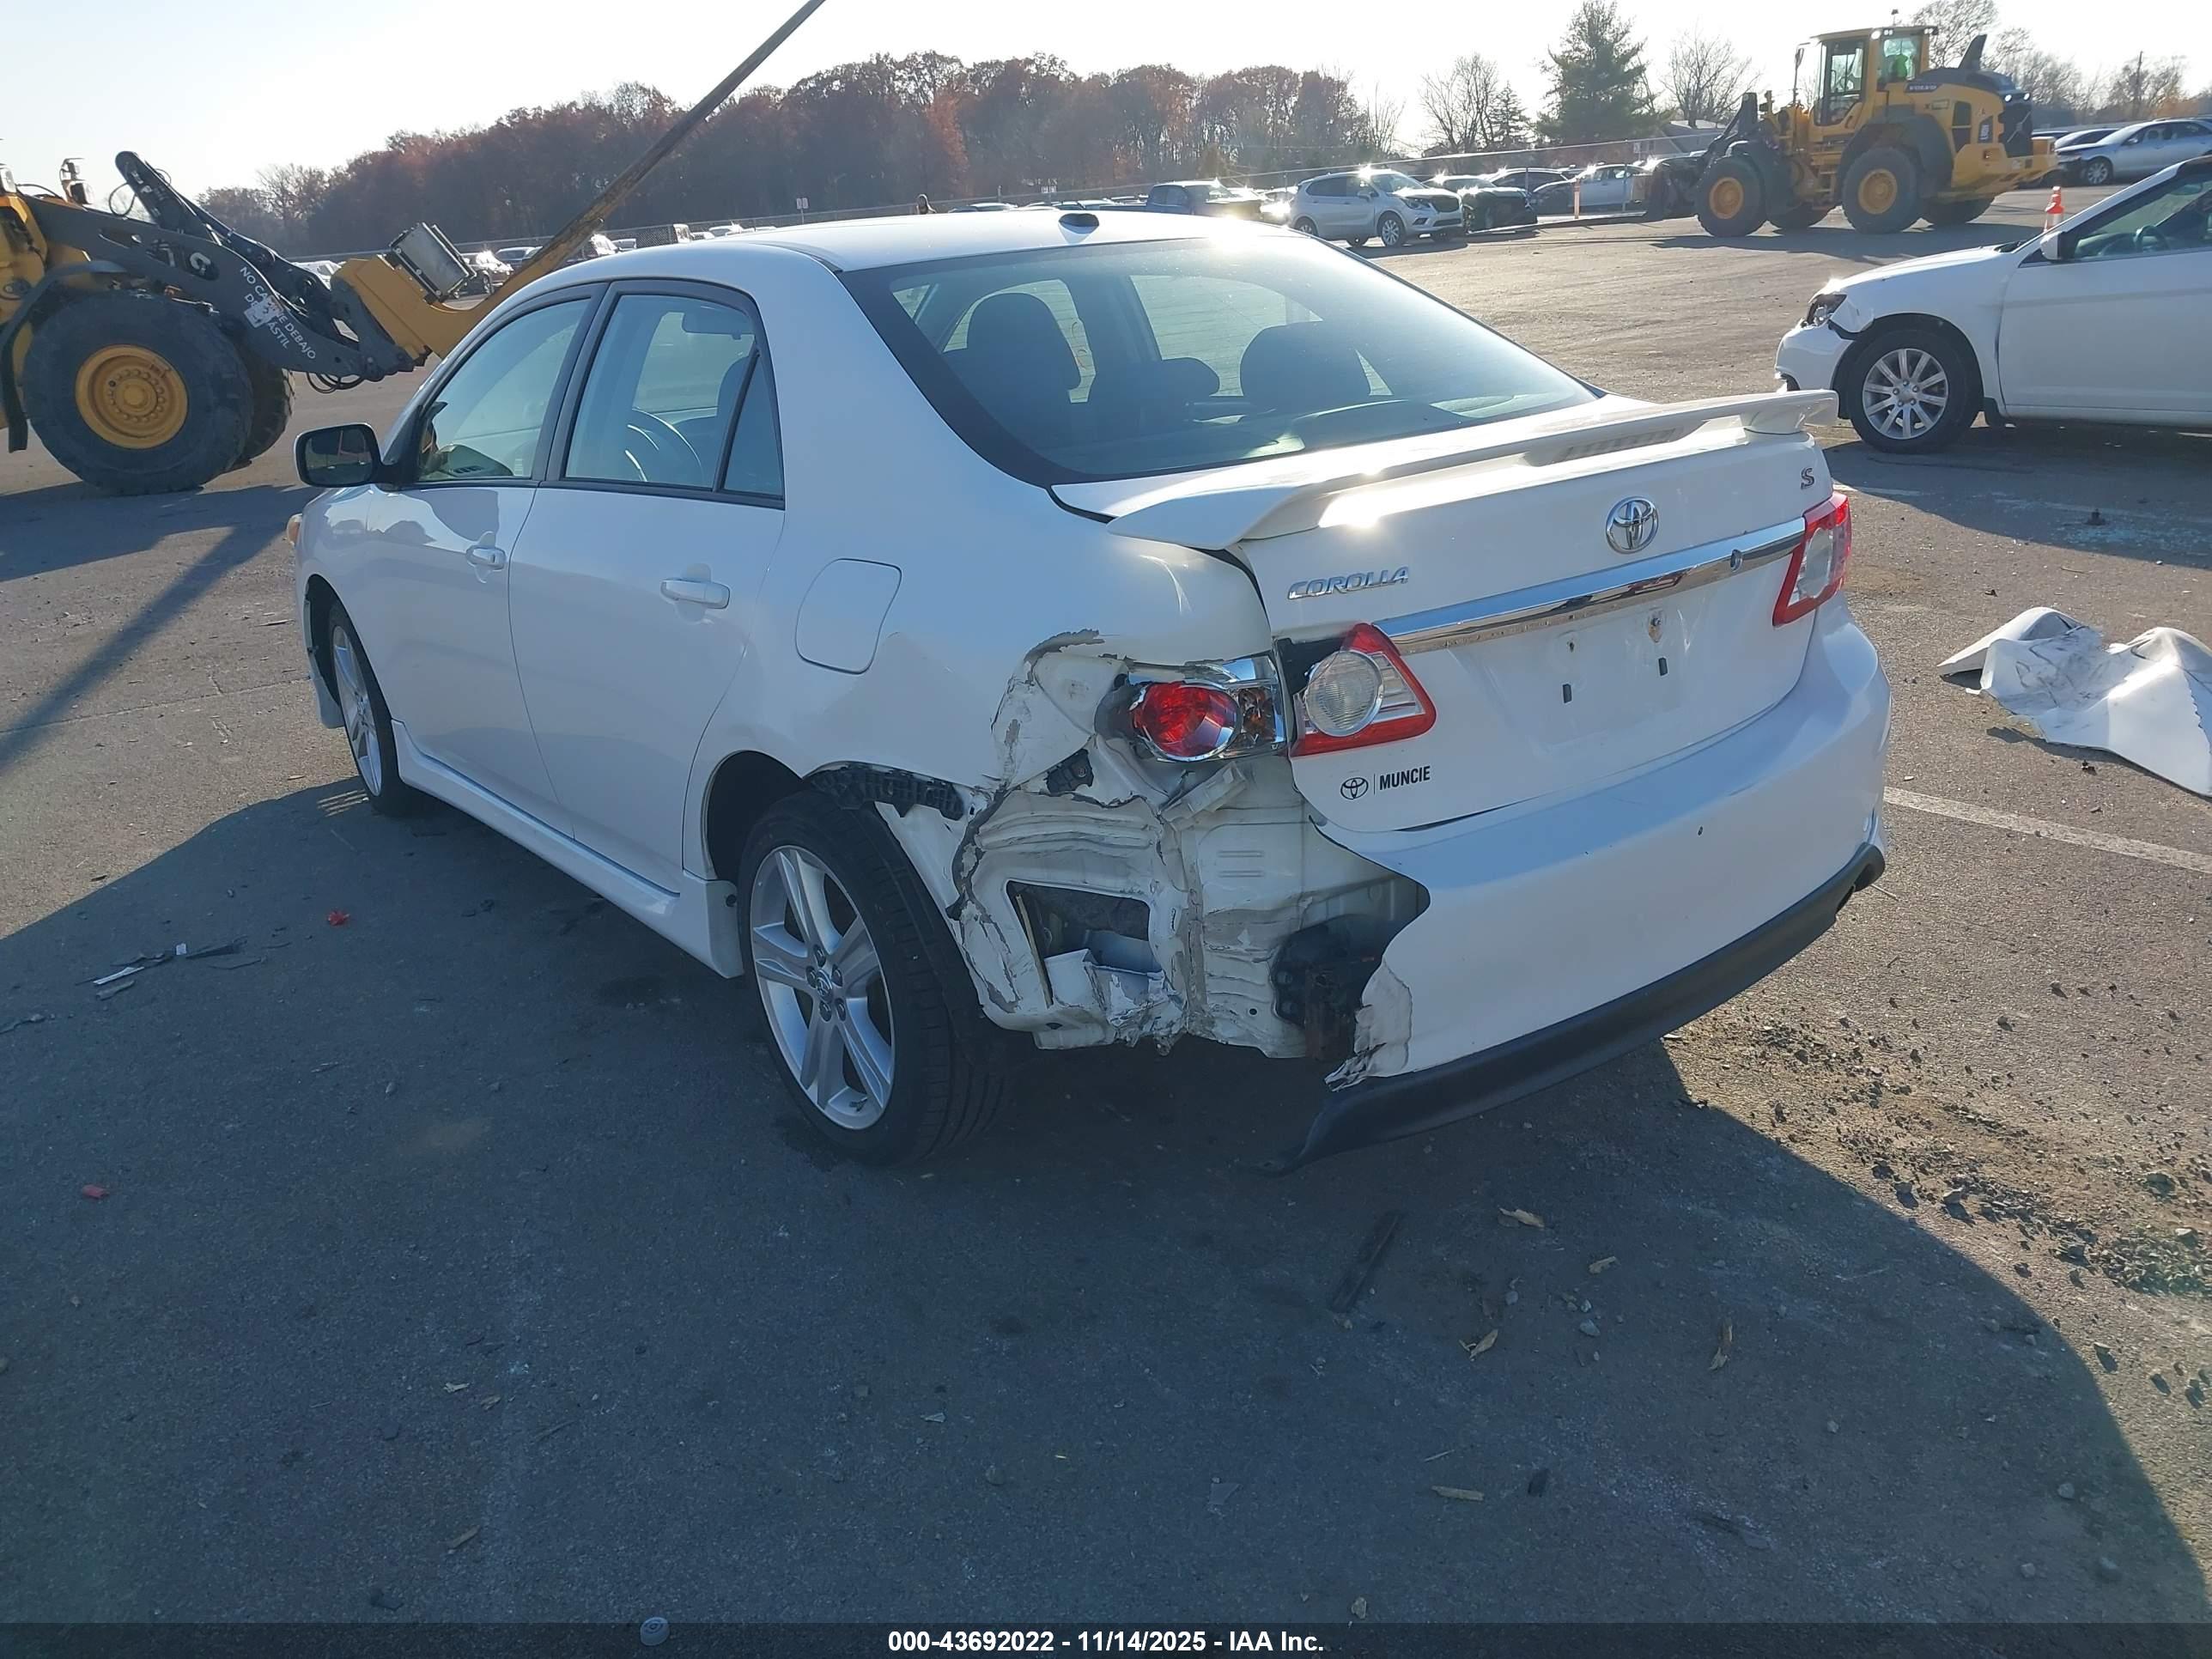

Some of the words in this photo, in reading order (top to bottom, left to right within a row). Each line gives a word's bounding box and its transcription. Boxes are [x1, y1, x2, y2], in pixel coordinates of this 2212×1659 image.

[240, 266, 256, 284] NO
[284, 322, 316, 359] DEBAJO
[267, 320, 290, 349] ÁSTIL
[1801, 467, 1815, 490] S
[1287, 566, 1409, 600] COROLLA
[1379, 765, 1431, 791] MUNCIE
